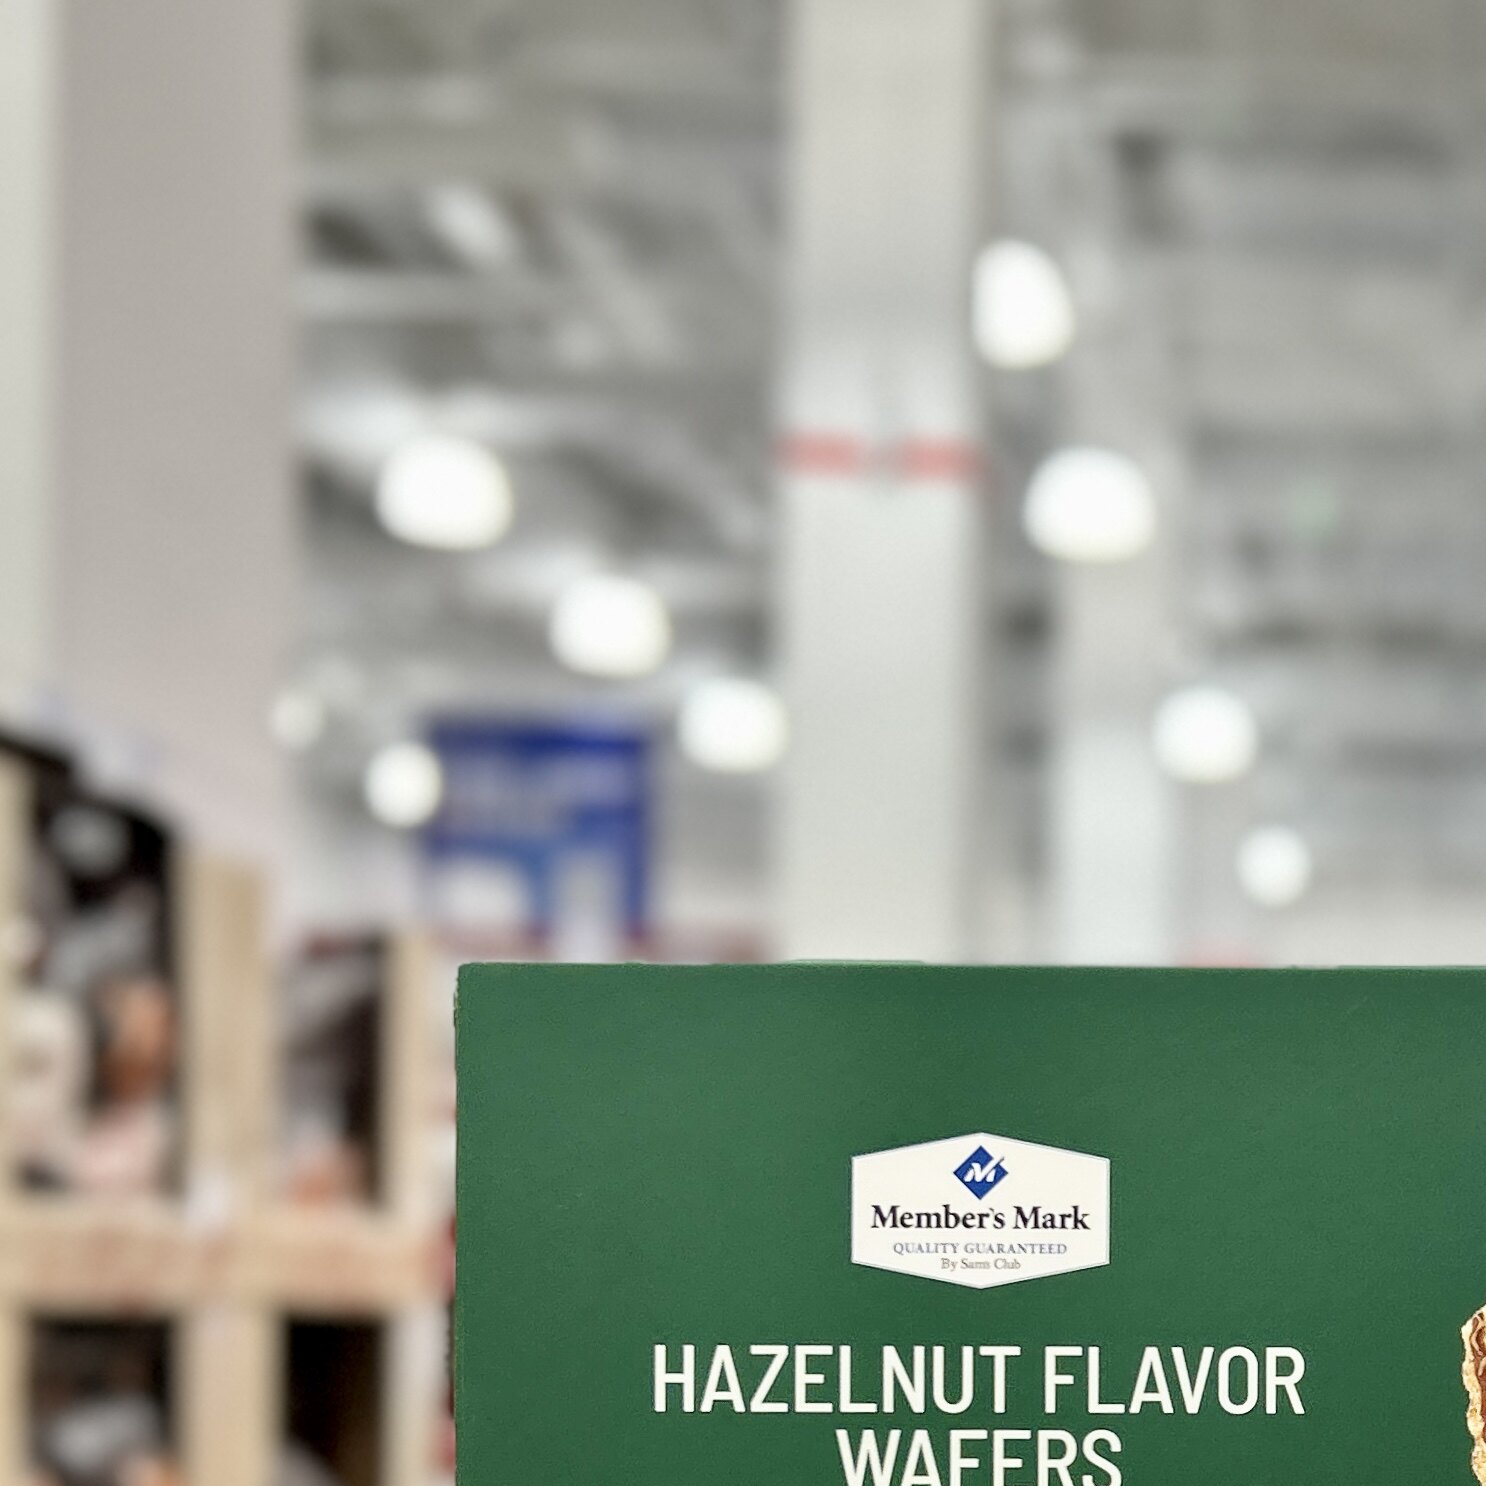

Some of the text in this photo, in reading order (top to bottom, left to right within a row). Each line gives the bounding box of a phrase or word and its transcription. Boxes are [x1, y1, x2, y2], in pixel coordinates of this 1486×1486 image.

[871, 1204, 1091, 1230] Member's Mark
[893, 1242, 1068, 1255] QUALITY GUARANTEED
[940, 1258, 957, 1271] By
[994, 1258, 1022, 1270] Club
[653, 1344, 1306, 1416] HAZELNUT FLAVOR
